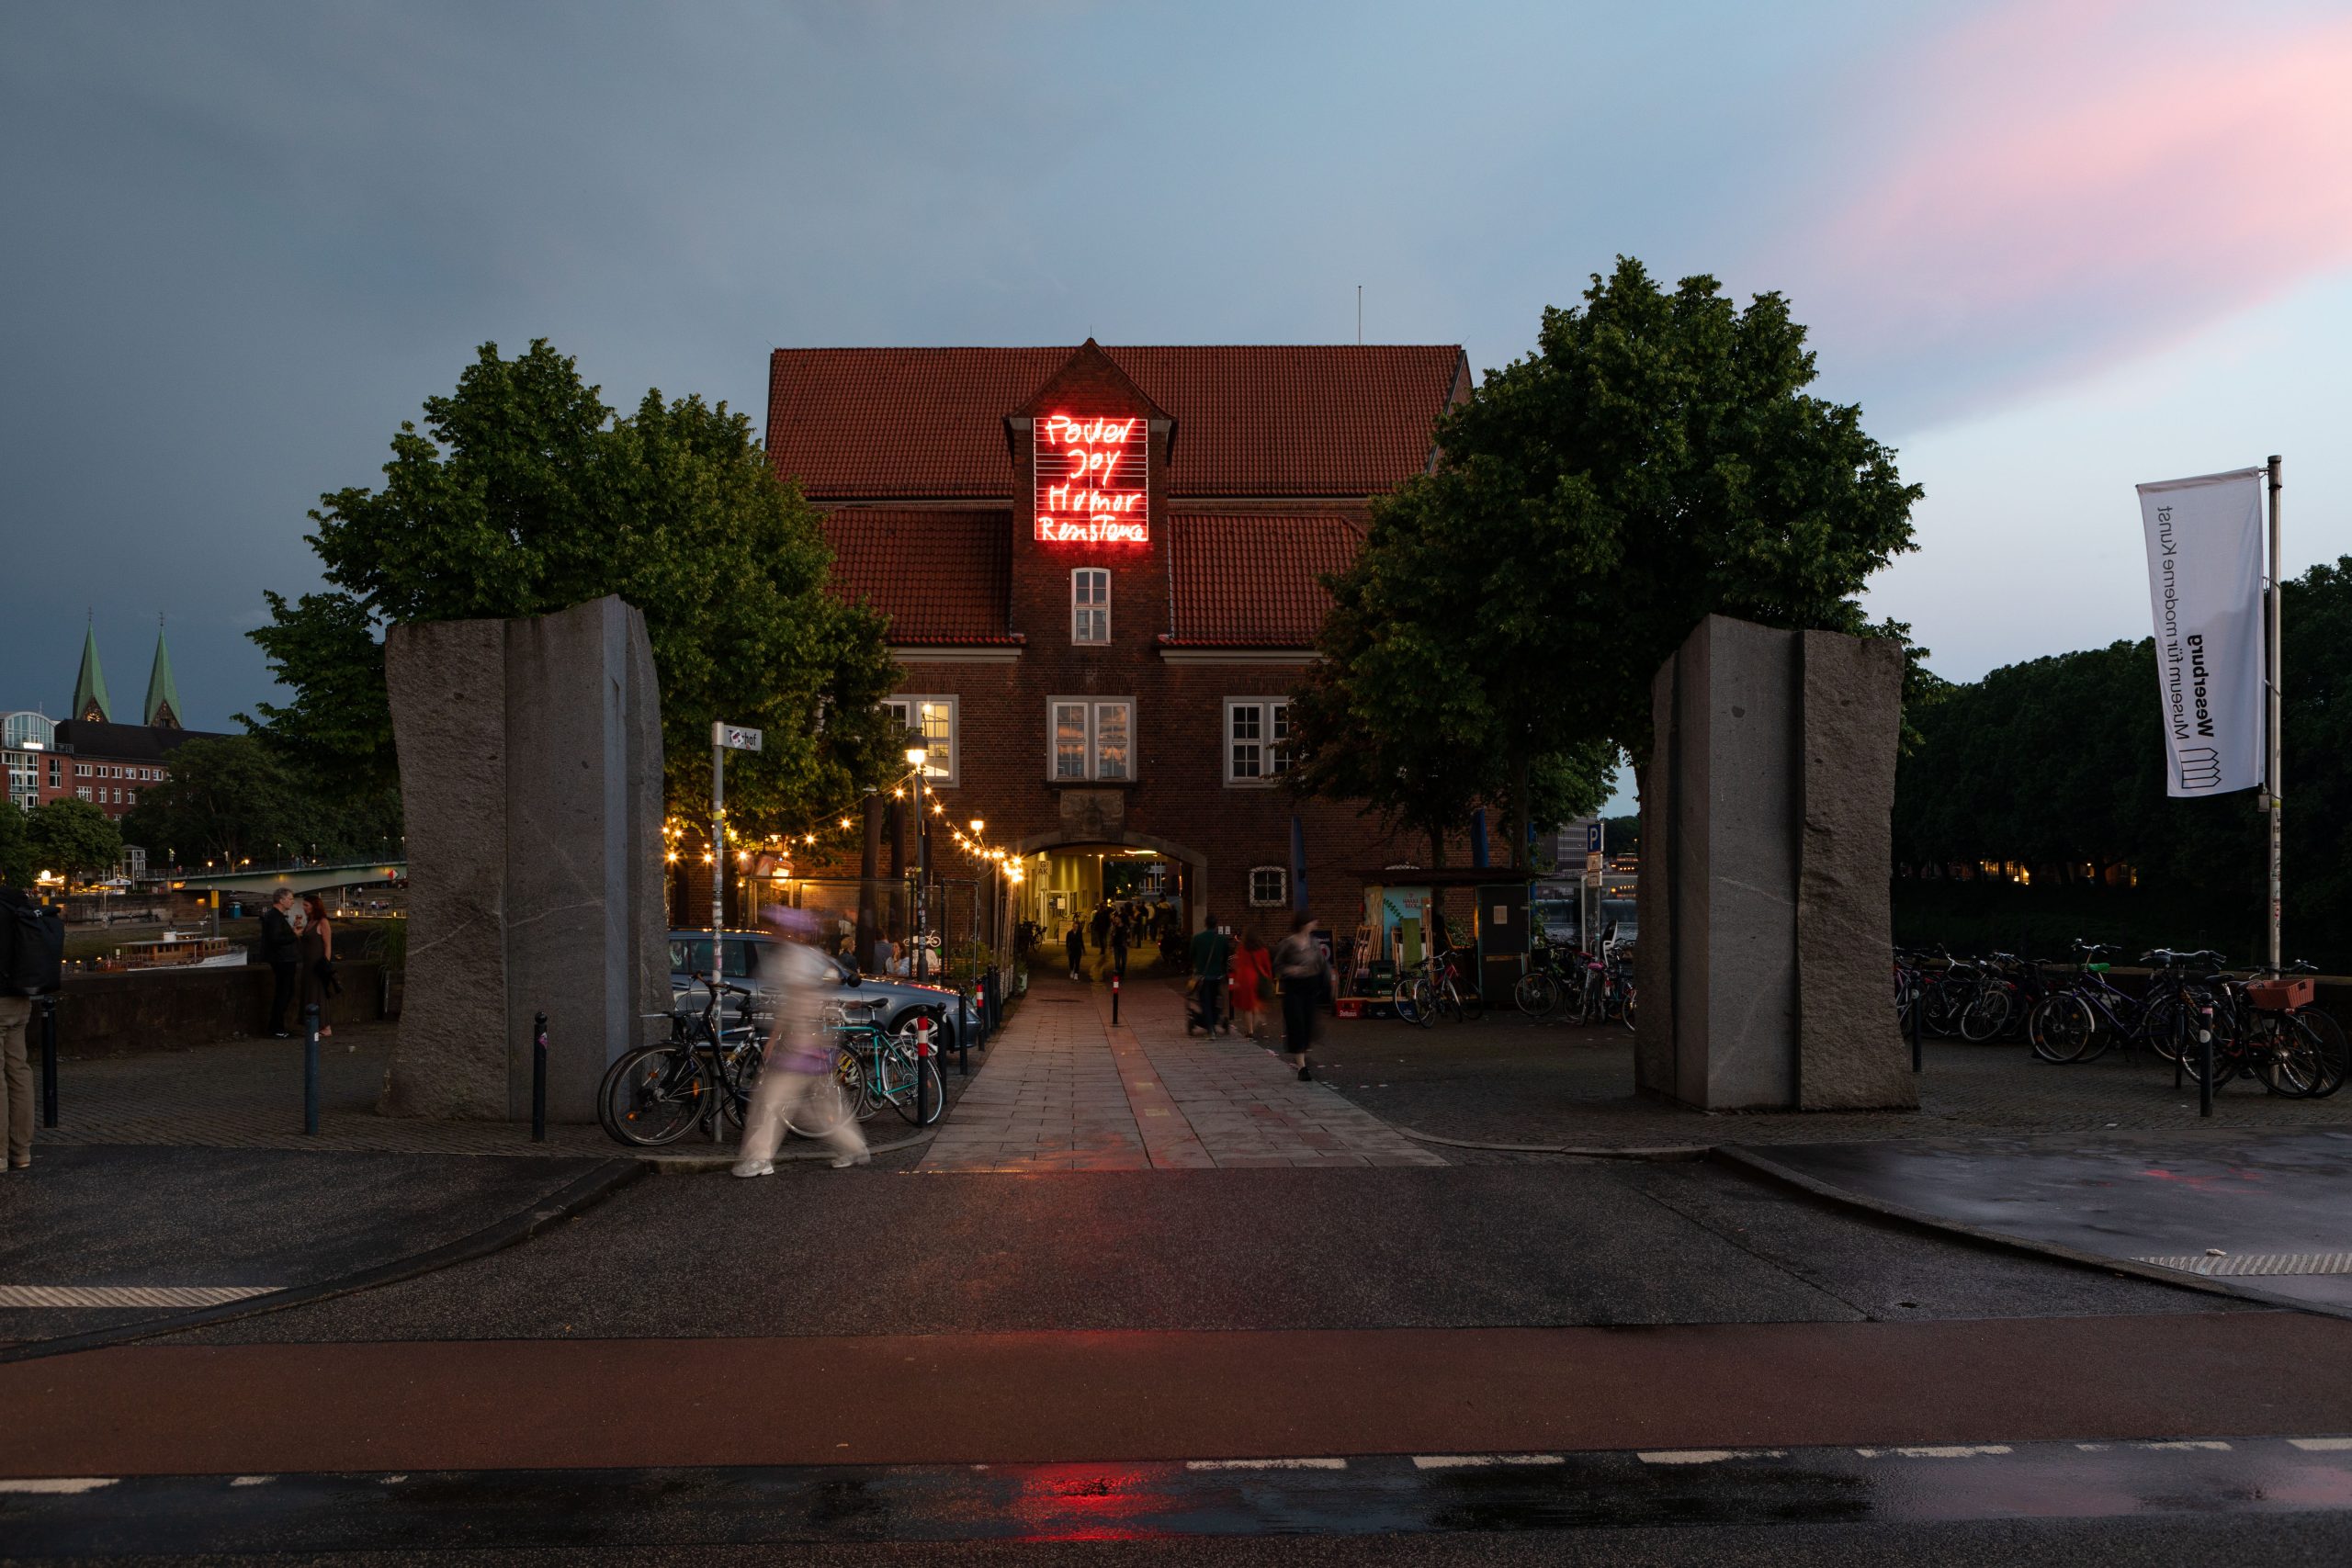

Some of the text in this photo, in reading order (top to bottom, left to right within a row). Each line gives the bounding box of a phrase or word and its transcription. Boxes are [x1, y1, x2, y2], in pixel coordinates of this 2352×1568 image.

[1068, 448, 1121, 486] Joy
[728, 729, 756, 746] Thof
[1589, 828, 1598, 850] P
